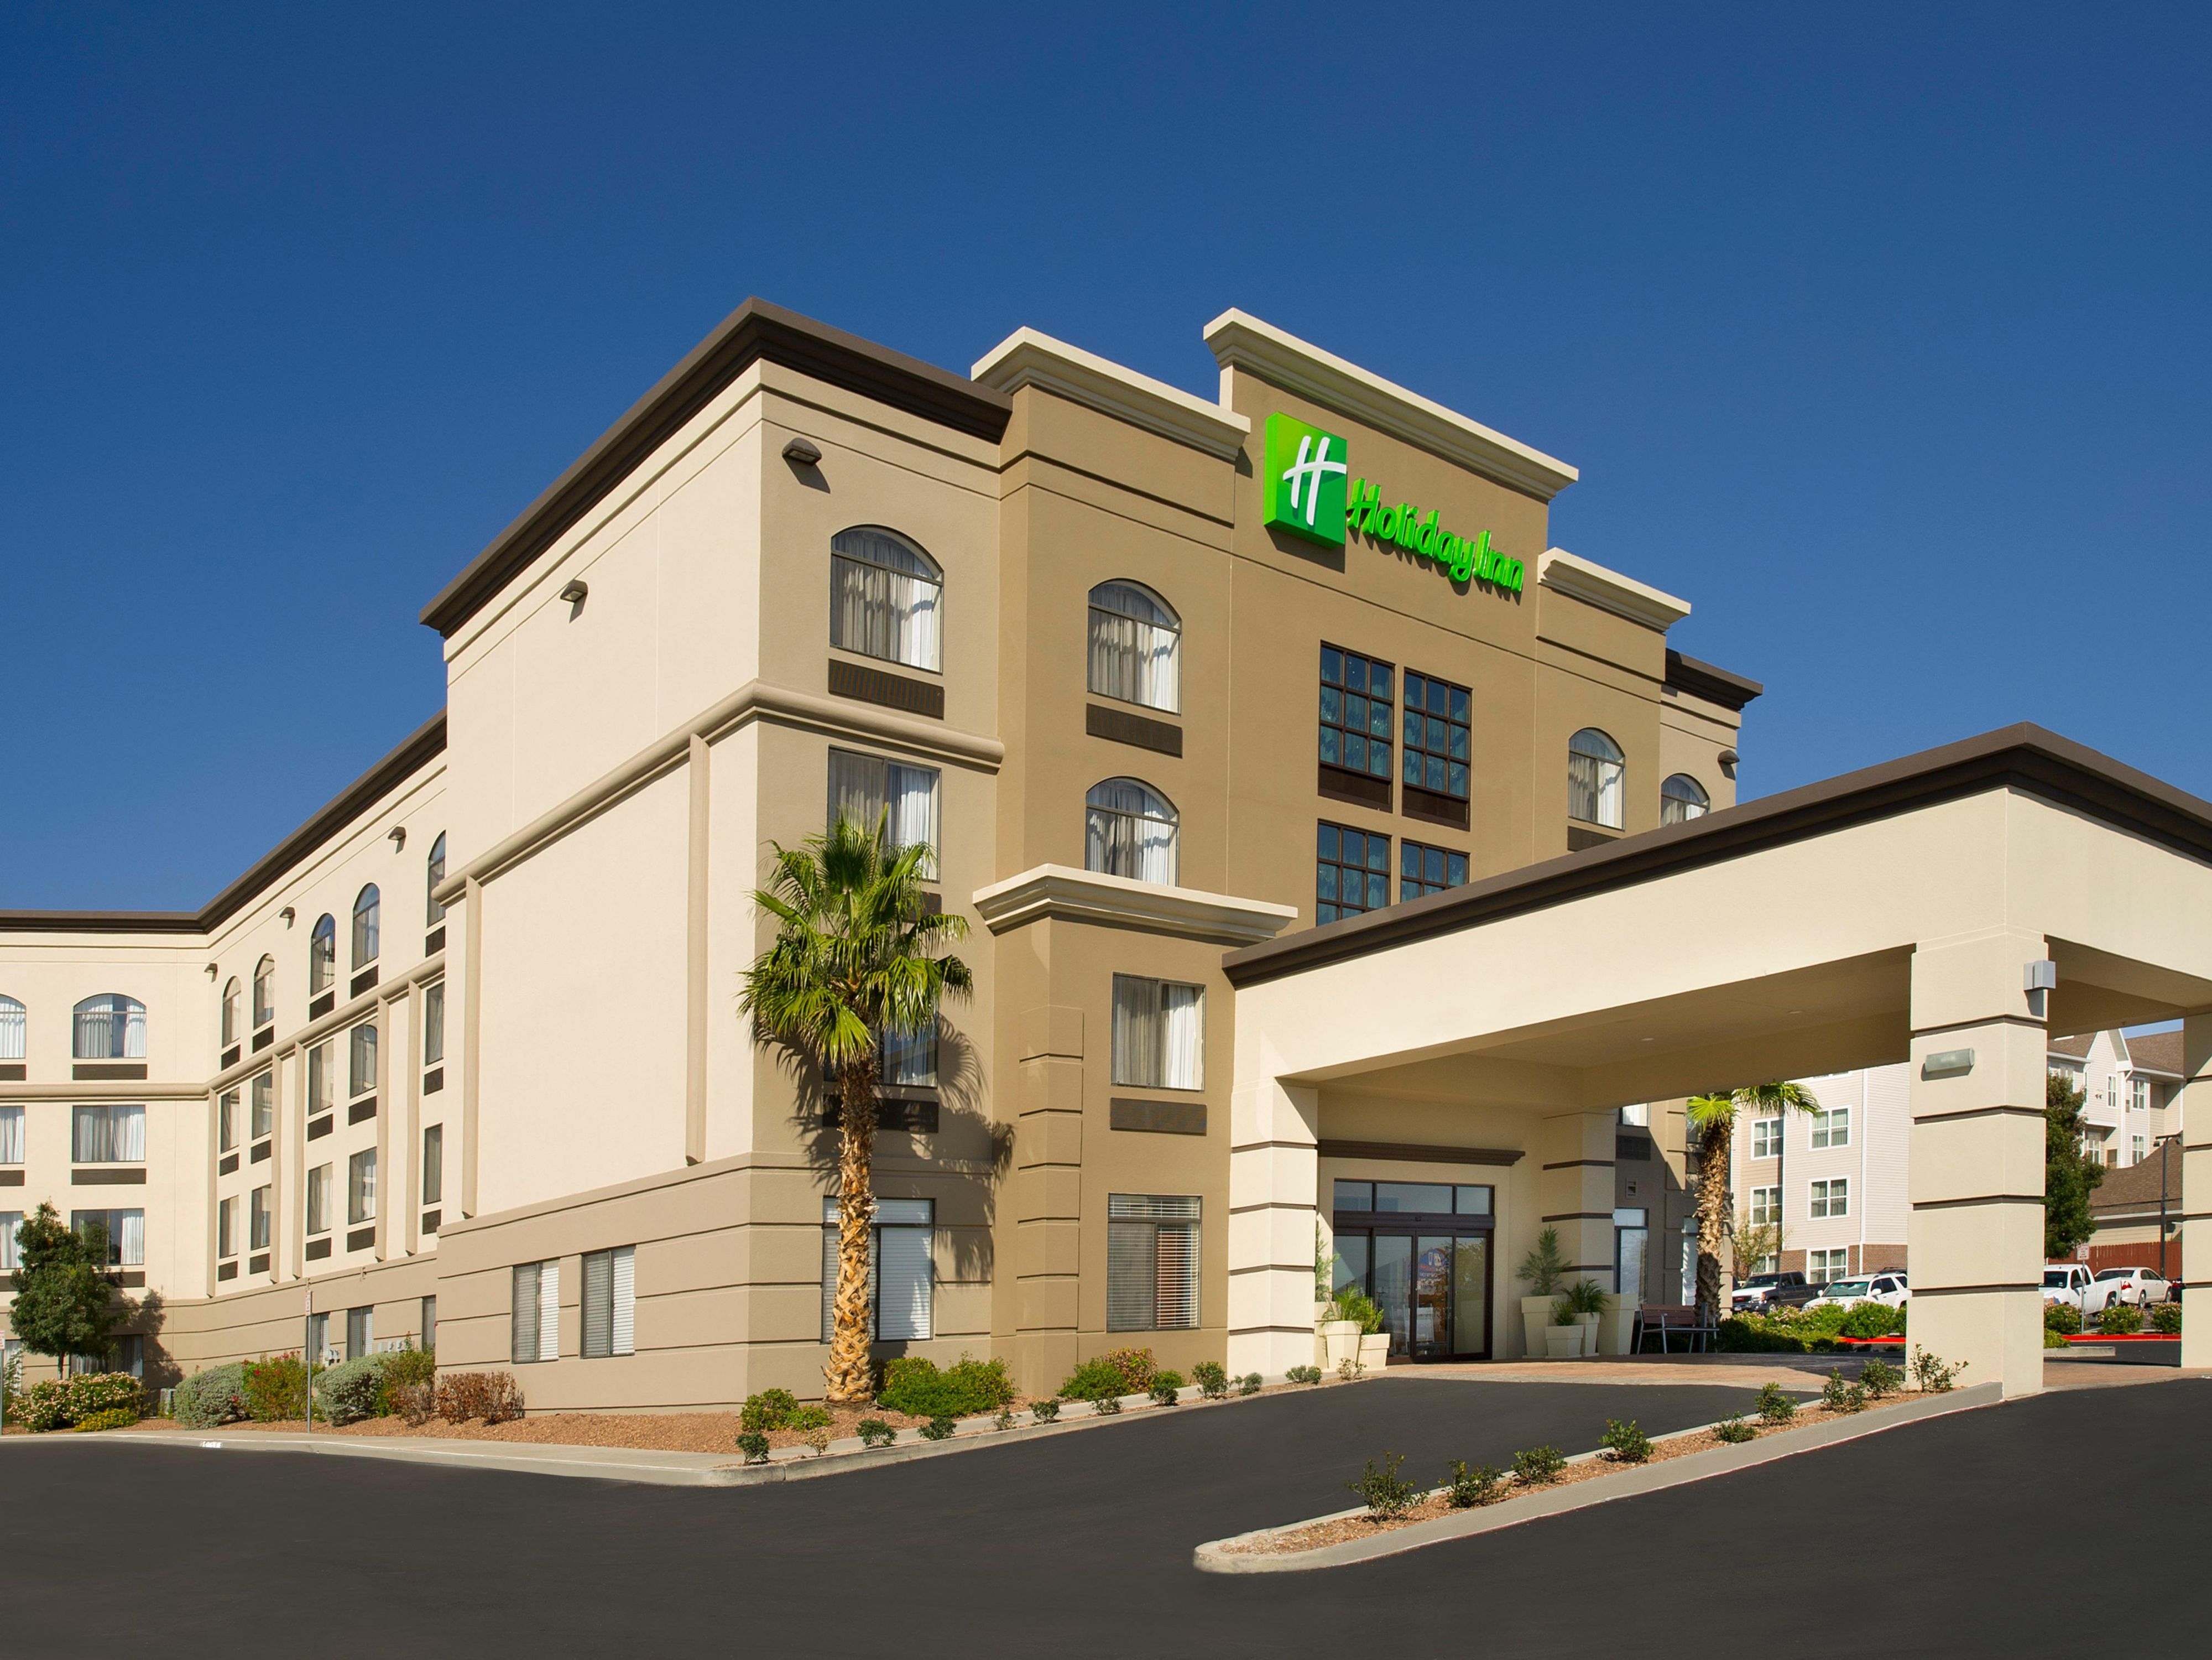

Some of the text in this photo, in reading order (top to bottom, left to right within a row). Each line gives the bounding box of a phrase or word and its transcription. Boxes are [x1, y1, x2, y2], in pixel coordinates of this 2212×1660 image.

[1282, 435, 1347, 525] H
[1346, 477, 1525, 592] Holiday Inn
